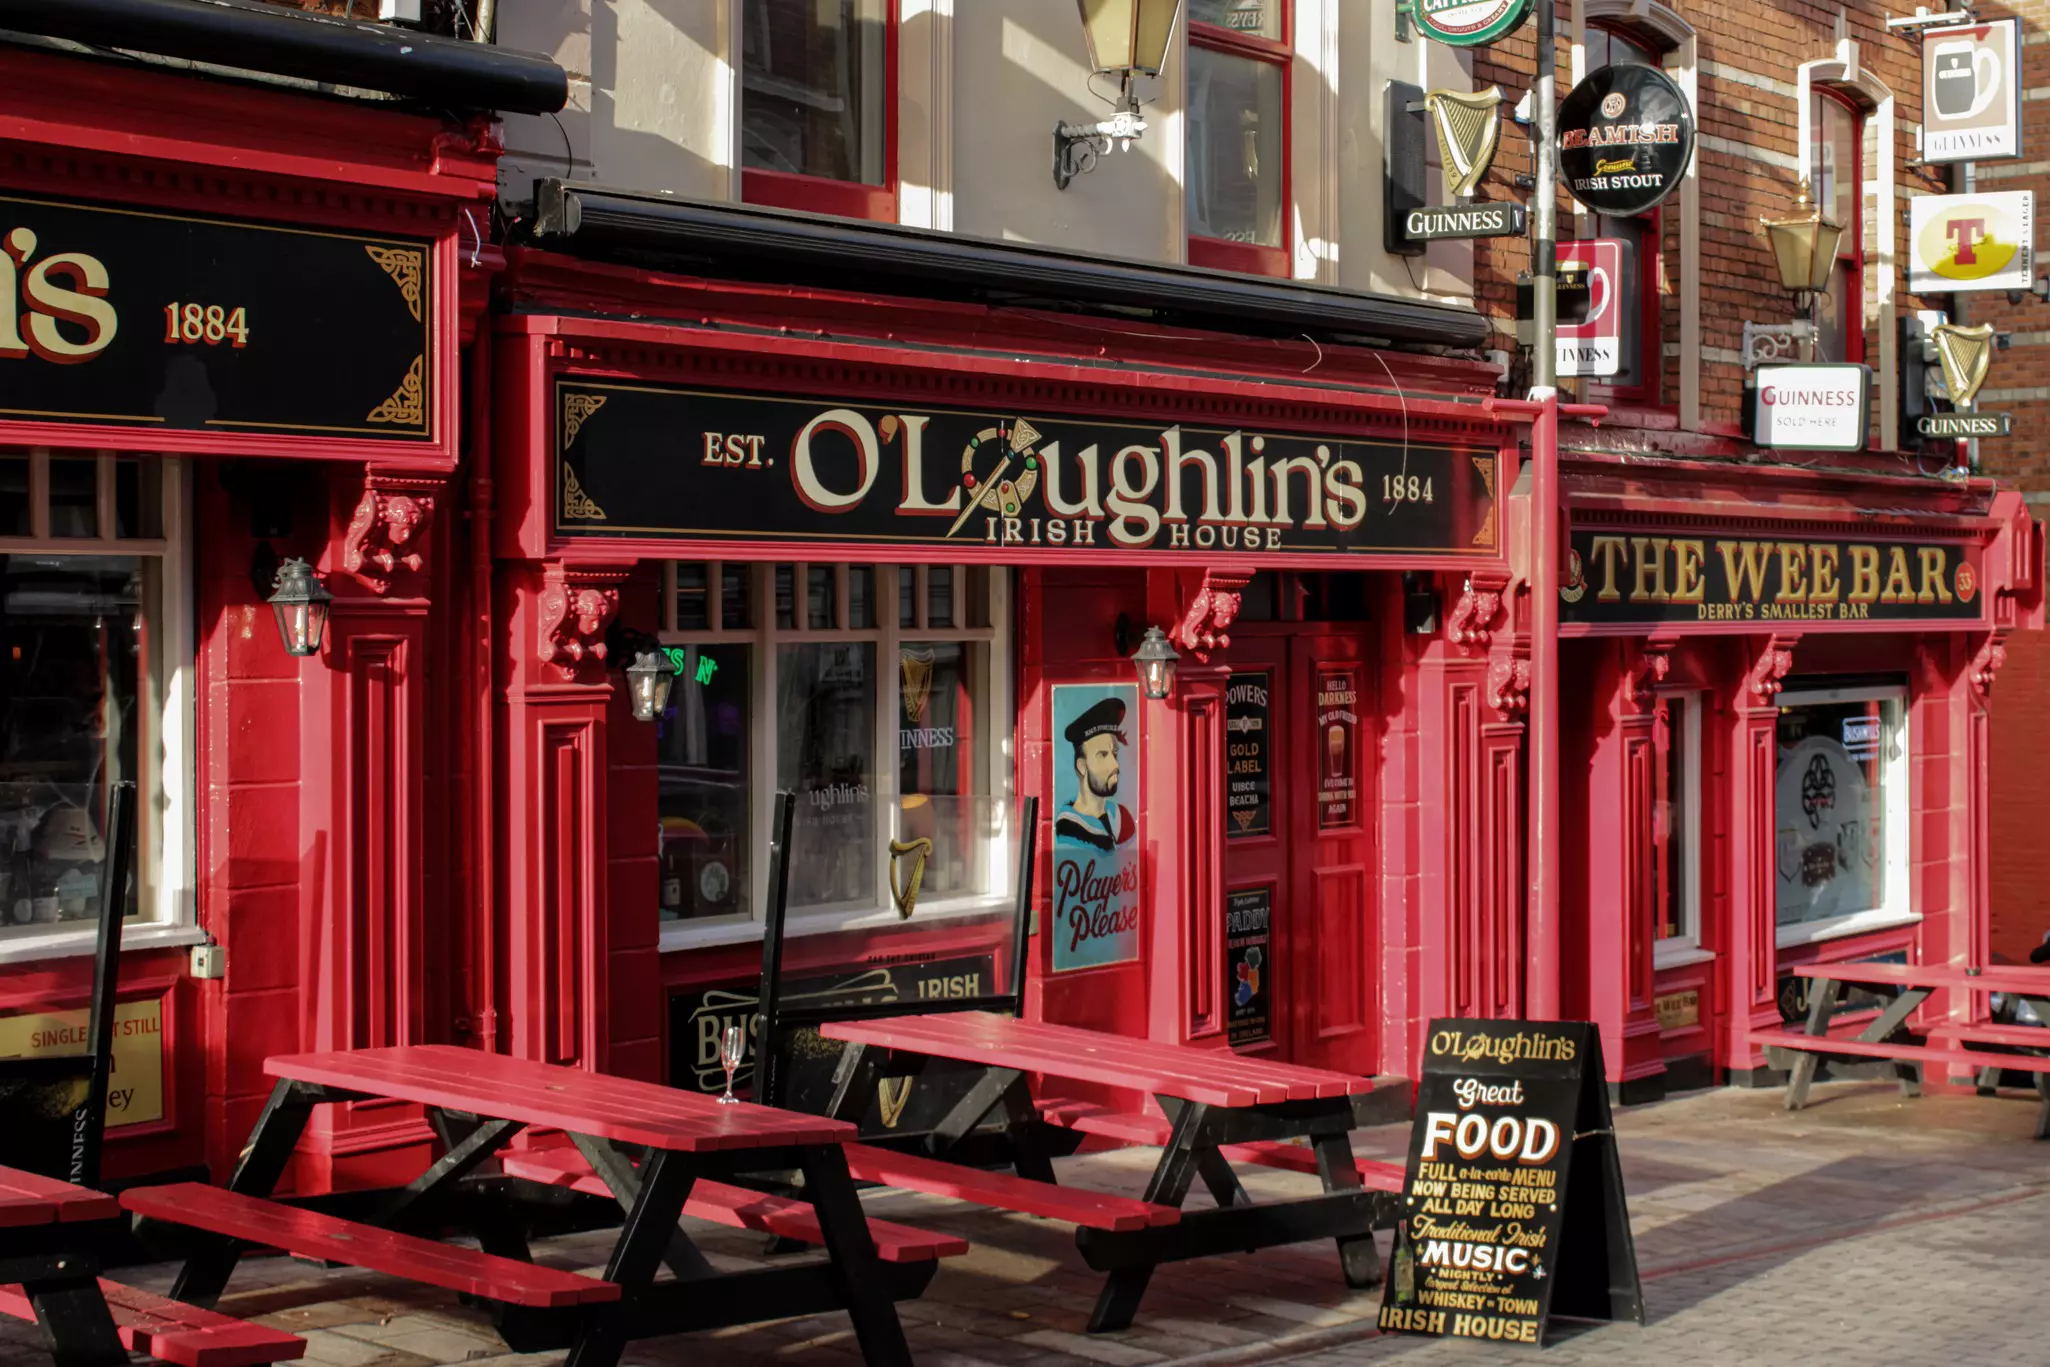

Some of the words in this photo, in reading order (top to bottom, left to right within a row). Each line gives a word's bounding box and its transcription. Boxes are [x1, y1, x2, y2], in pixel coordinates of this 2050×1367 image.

[1562, 123, 1679, 150] BEAMISH
[1574, 176, 1609, 191] IRISH
[1611, 173, 1664, 188] STOUT
[1406, 209, 1504, 234] GUINNESS
[163, 300, 251, 349] 1884
[1560, 346, 1611, 362] INNESS
[1761, 385, 1855, 406] GUINNESS
[1776, 416, 1806, 427] SOLD
[1809, 417, 1838, 427] HERE
[1916, 417, 1998, 434] GUINNESS
[700, 430, 775, 470] EST.
[1381, 473, 1435, 504] 1884
[984, 515, 1097, 546] IRISH
[1168, 522, 1283, 550] HOUSE
[1591, 535, 1705, 605] THE
[1715, 539, 1842, 605] WEE
[1847, 543, 1953, 606] BAR
[1698, 601, 1755, 620] DERRY'S
[1760, 602, 1835, 620] SMALLEST
[1839, 602, 1870, 620] BAR
[1318, 690, 1357, 707] DARKNESS
[900, 727, 953, 750] INNESS
[1230, 742, 1259, 756] GOLD
[1227, 759, 1262, 774] LABEL
[1057, 858, 1138, 919] Player's
[1069, 903, 1138, 953] Please
[1226, 906, 1271, 933] PADDY
[917, 972, 980, 999] IRISH
[31, 1026, 88, 1049] SINGLE
[123, 1017, 160, 1036] STILL
[1453, 1077, 1524, 1110] Great
[69, 1107, 89, 1184] INNESS
[1420, 1111, 1561, 1166] FOOD
[1418, 1162, 1457, 1182] FULL
[1511, 1168, 1557, 1188] MENU
[1411, 1179, 1448, 1197] NOW
[1450, 1182, 1496, 1200] BEING
[1498, 1185, 1557, 1204] SERVED
[1421, 1198, 1453, 1215] ALL
[1455, 1199, 1485, 1216] DAY
[1490, 1202, 1536, 1219] LONG
[1410, 1213, 1504, 1244] Traditional
[1502, 1221, 1548, 1248] Irish
[1420, 1240, 1530, 1275] MUSIC
[1438, 1267, 1496, 1283] NIGHTLY
[1418, 1290, 1488, 1311] WHISKEY
[1497, 1297, 1539, 1316] TOWN
[1380, 1305, 1447, 1334] IRISH
[1452, 1313, 1539, 1343] HOUSE
